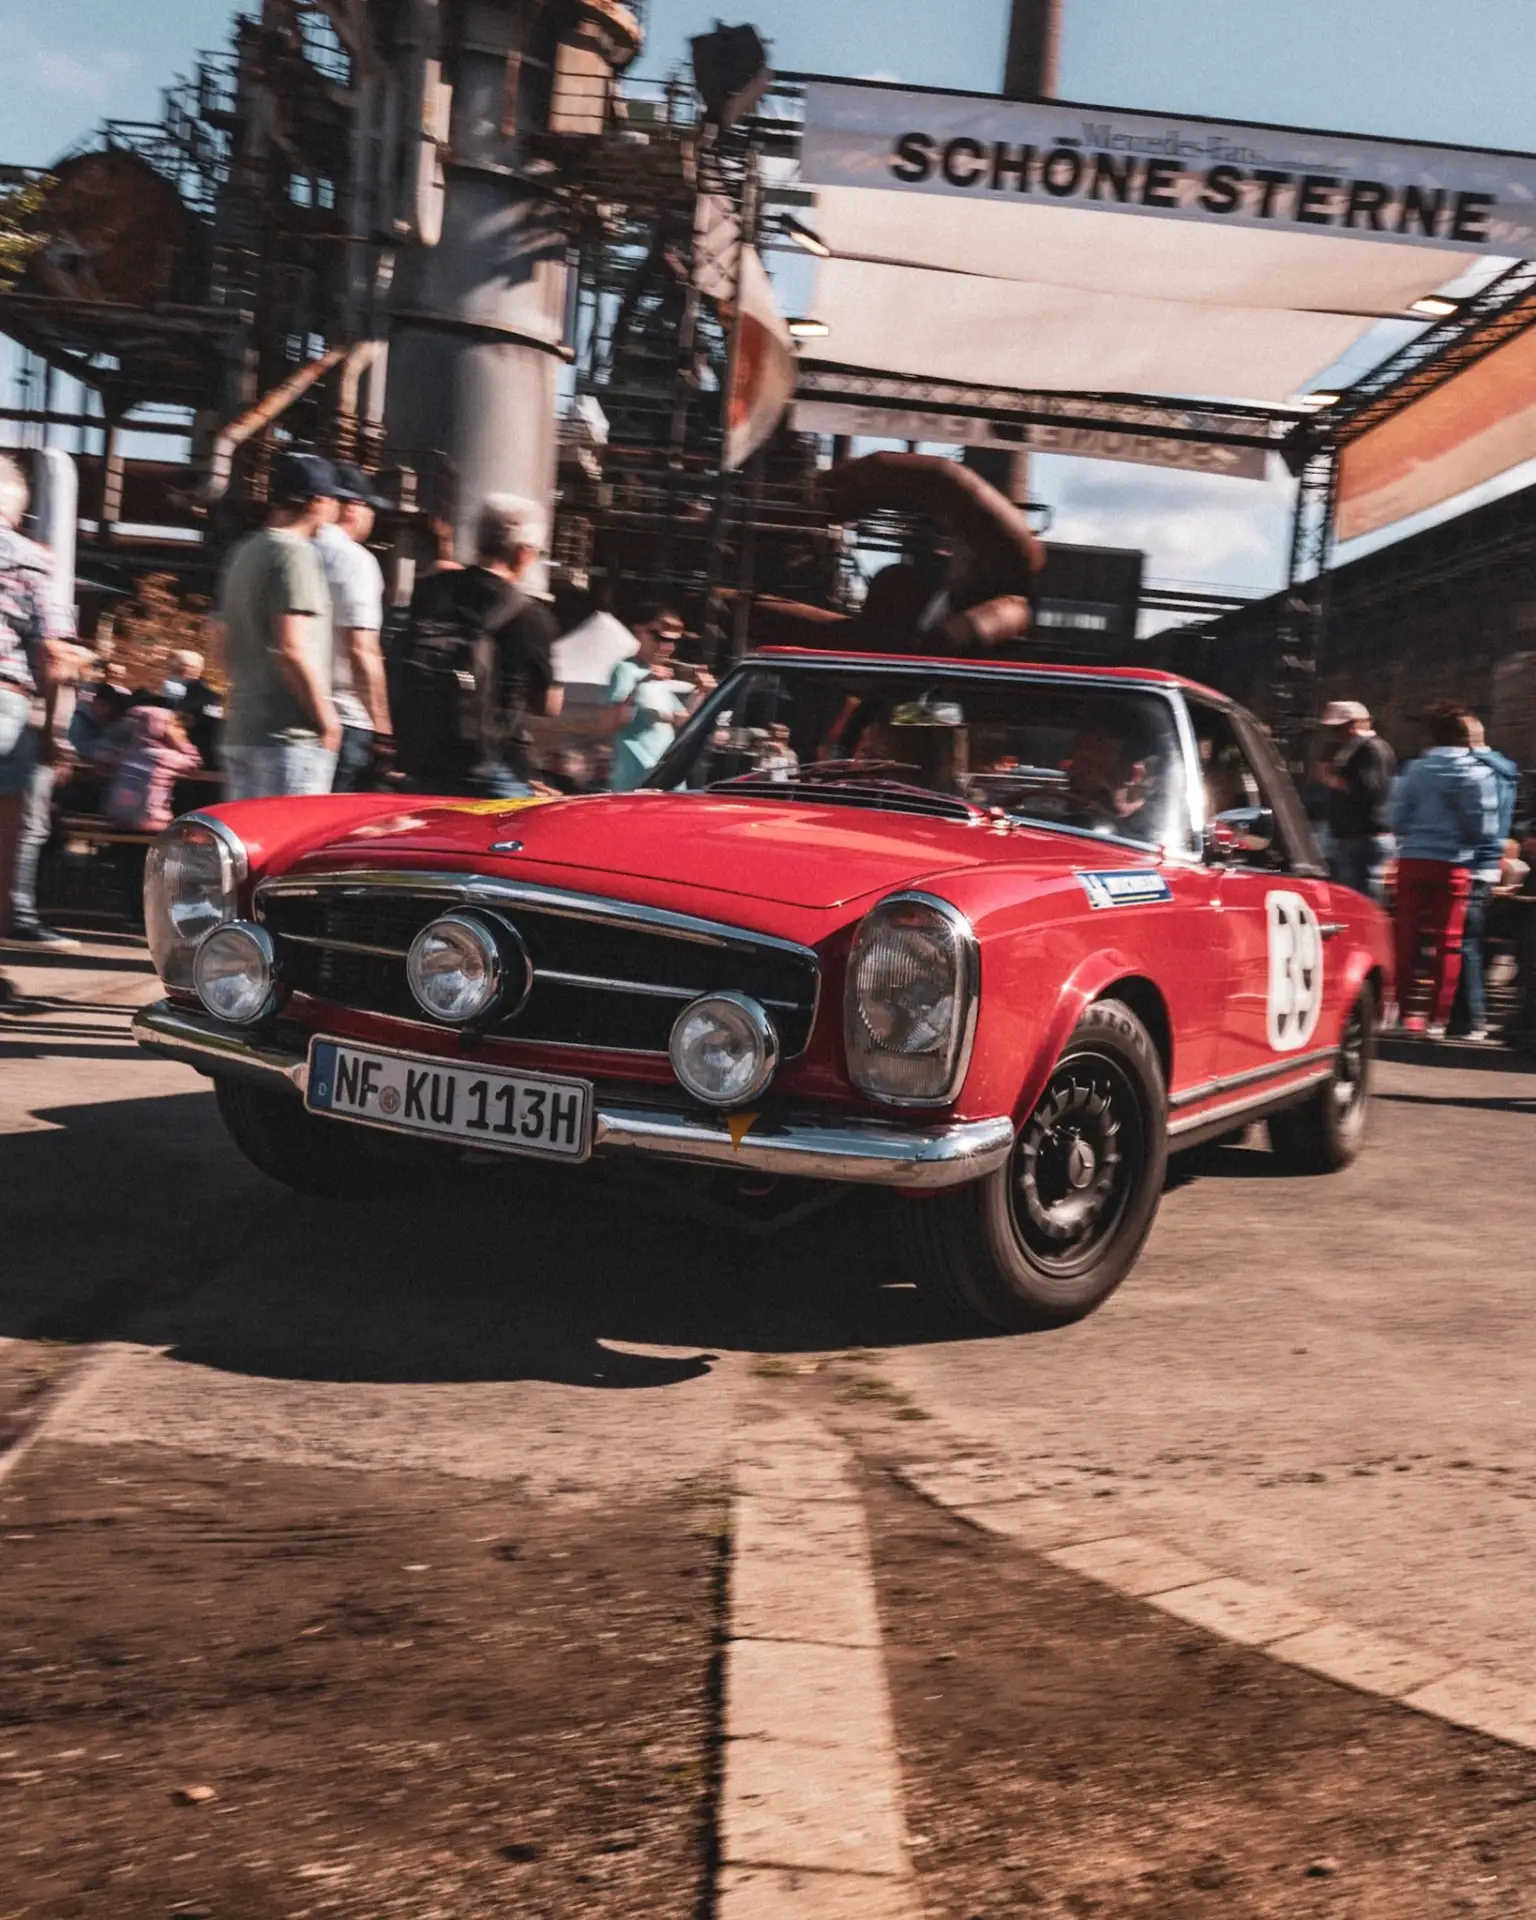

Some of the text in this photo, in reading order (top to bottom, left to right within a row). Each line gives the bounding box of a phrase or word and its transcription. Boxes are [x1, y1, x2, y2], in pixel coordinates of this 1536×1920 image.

[889, 132, 1497, 243] SCHÖNE STERNE
[317, 1082, 327, 1097] D
[335, 1054, 577, 1145] NF KU 113H
